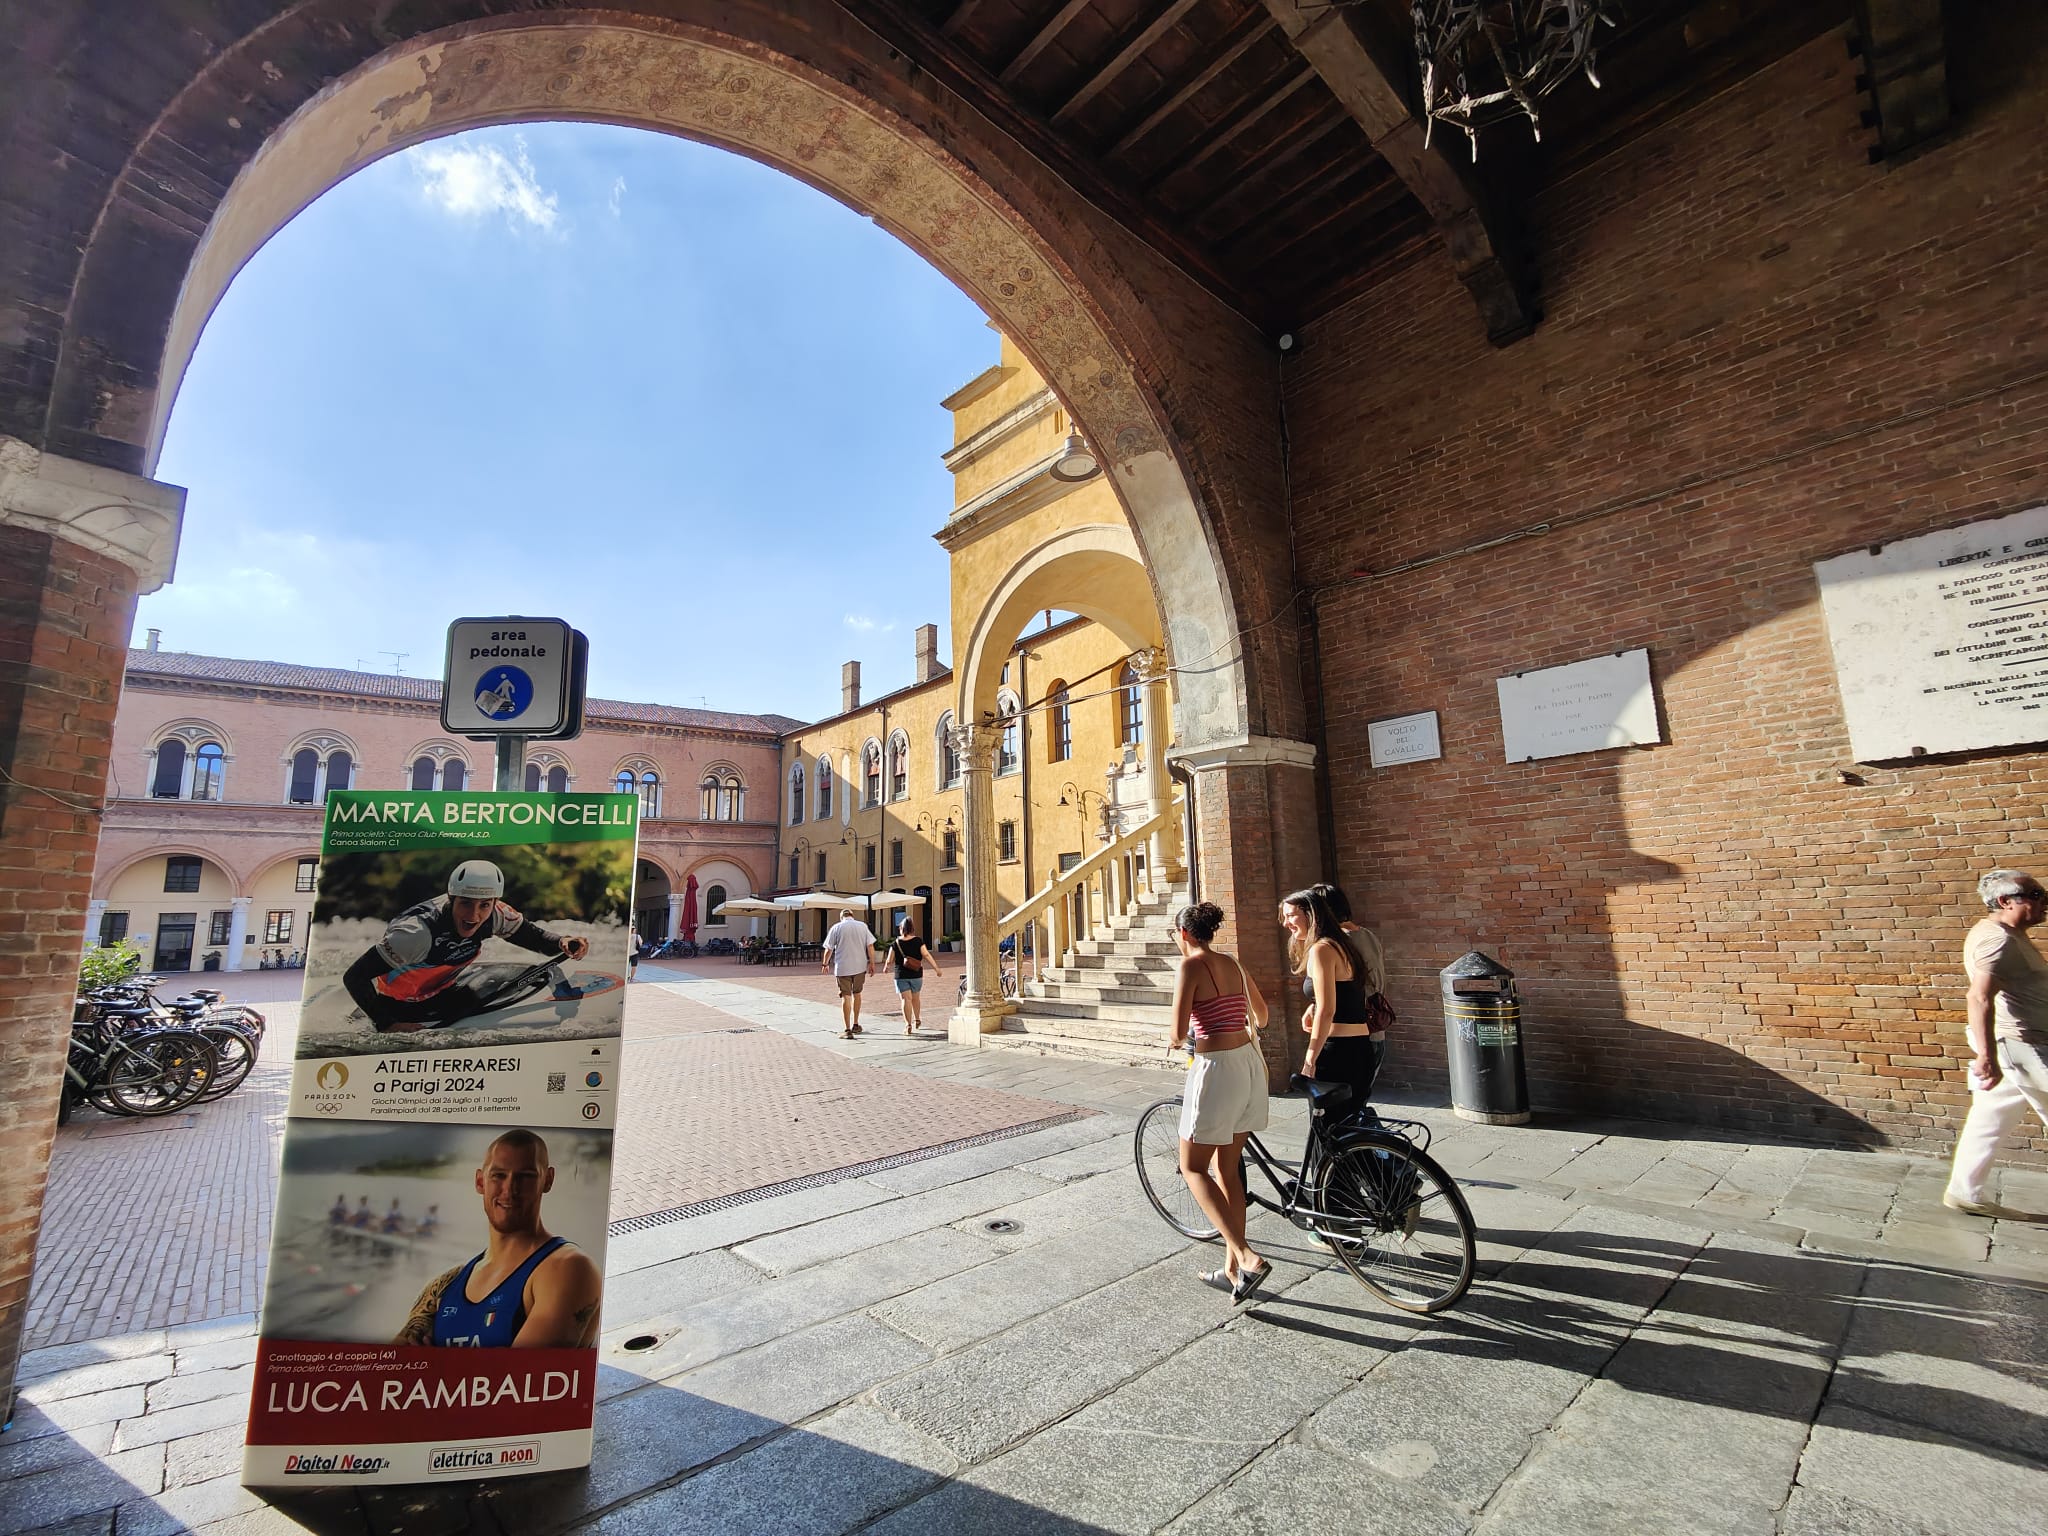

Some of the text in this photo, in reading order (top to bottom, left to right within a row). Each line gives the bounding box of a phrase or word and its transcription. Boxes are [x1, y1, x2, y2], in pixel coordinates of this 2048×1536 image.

[2002, 545, 2012, 554] E
[1953, 572, 2003, 587] FATICOSO
[1962, 587, 1981, 596] MAI
[2009, 579, 2025, 587] LO
[1967, 612, 2035, 629] CONSERVINO
[491, 631, 526, 640] area
[1995, 626, 2022, 636] NOMI
[1956, 640, 2006, 653] CITTADINI
[2012, 635, 2036, 643] CHE
[470, 645, 546, 659] pedonale
[1388, 725, 1417, 735] VOLTO
[1384, 743, 1424, 756] CAVALLO
[332, 802, 632, 825] MARTA BERTONCELLI
[375, 1058, 521, 1073] ATLETI FERRARESI
[373, 1078, 485, 1095] a Parigi 2024
[453, 1097, 472, 1105] luglio
[492, 1096, 518, 1104] agosto
[442, 1106, 467, 1114] agosto
[269, 1353, 326, 1363] Canottaggio
[335, 1352, 343, 1360] di
[345, 1352, 377, 1362] coppia
[379, 1350, 396, 1360] (4X)
[267, 1365, 292, 1373] Prima
[328, 1363, 371, 1372] Canottieri
[371, 1363, 402, 1371] Ferrara
[403, 1361, 429, 1370] A.S.D.
[268, 1369, 579, 1413] LUCA RAMBALDI
[286, 1455, 338, 1471] Digital
[433, 1448, 533, 1468] elettrica neon
